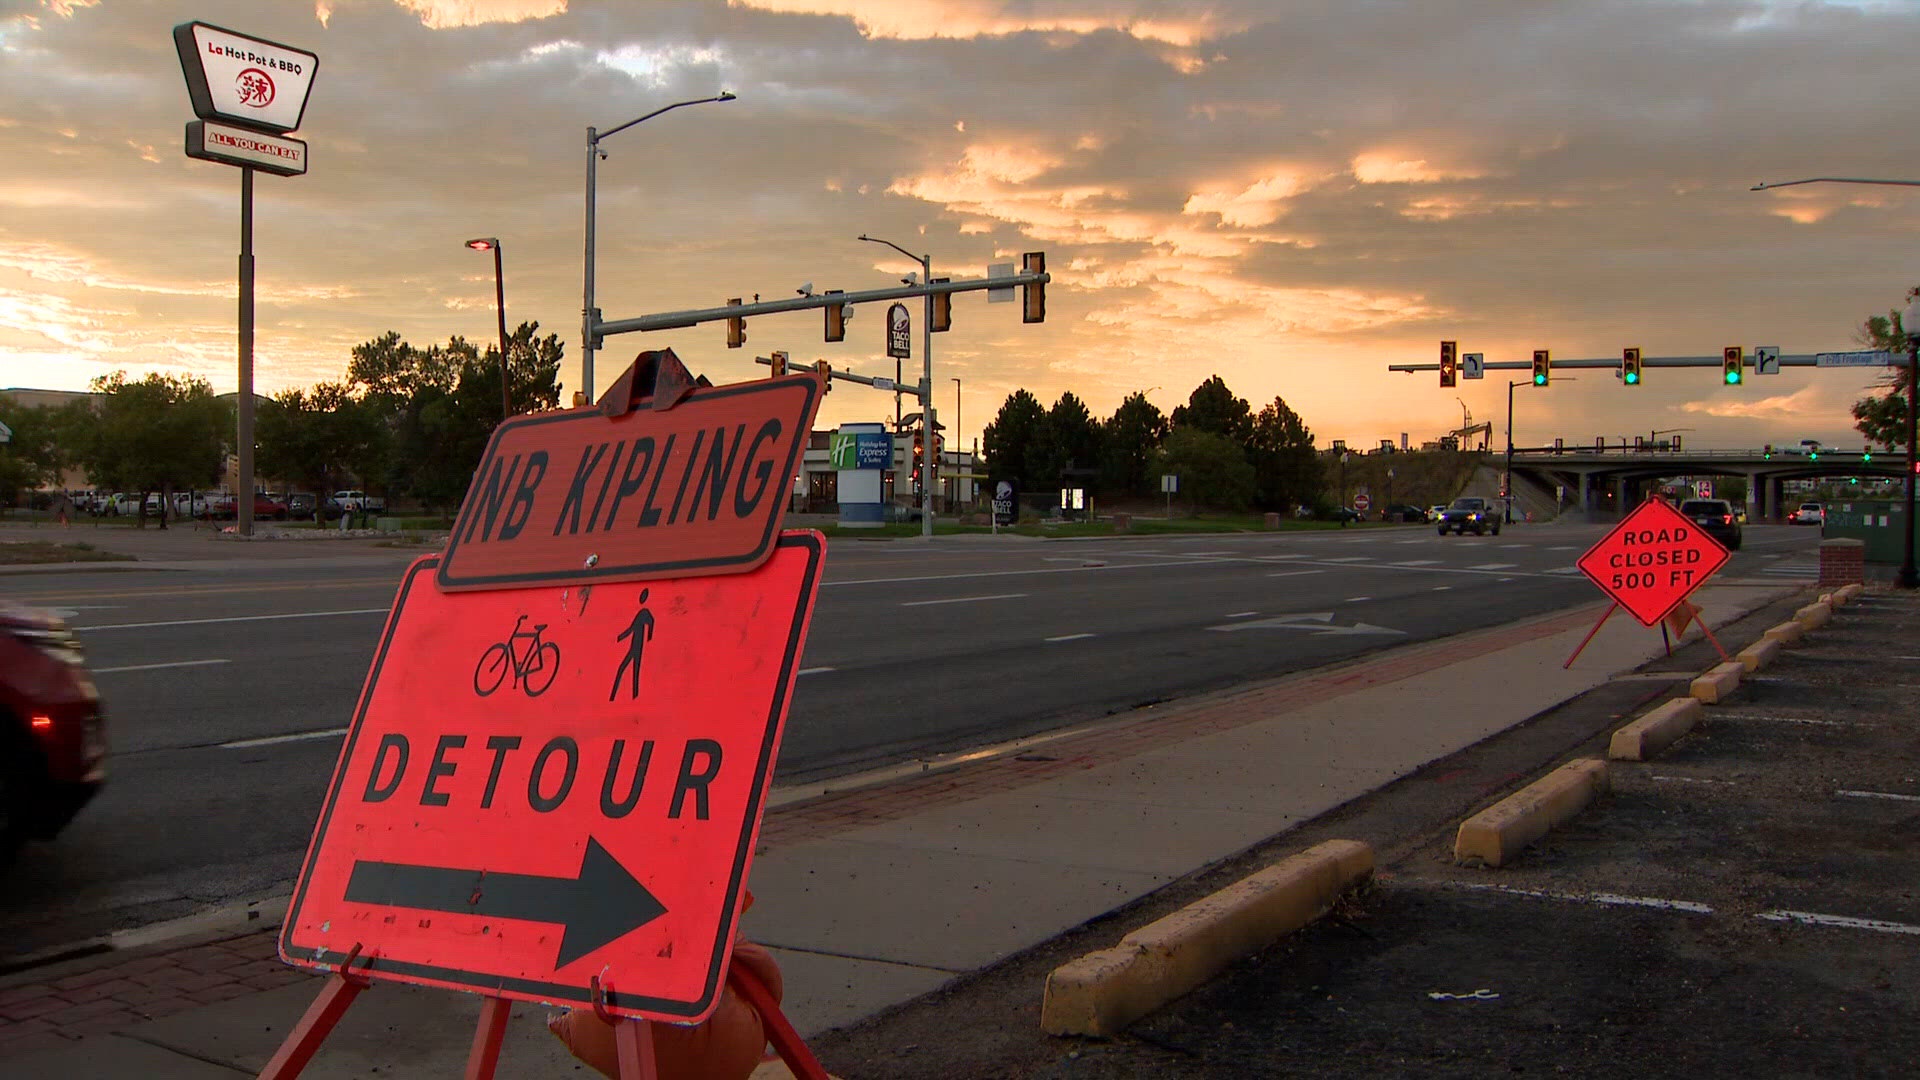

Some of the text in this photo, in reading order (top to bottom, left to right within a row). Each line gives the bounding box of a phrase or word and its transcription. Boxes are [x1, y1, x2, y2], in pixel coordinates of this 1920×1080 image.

[208, 42, 302, 75] La Hot Pot & BBQ
[208, 132, 299, 160] ALL YOU CAN EAT
[892, 330, 910, 340] TACO
[893, 340, 910, 350] BELL
[859, 448, 888, 458] Express
[463, 418, 783, 544] NB KIPLING
[1623, 528, 1688, 546] ROAD
[1610, 549, 1700, 568] CLOSED
[1612, 570, 1695, 589] 500 FT
[362, 733, 723, 821] DETOUR
